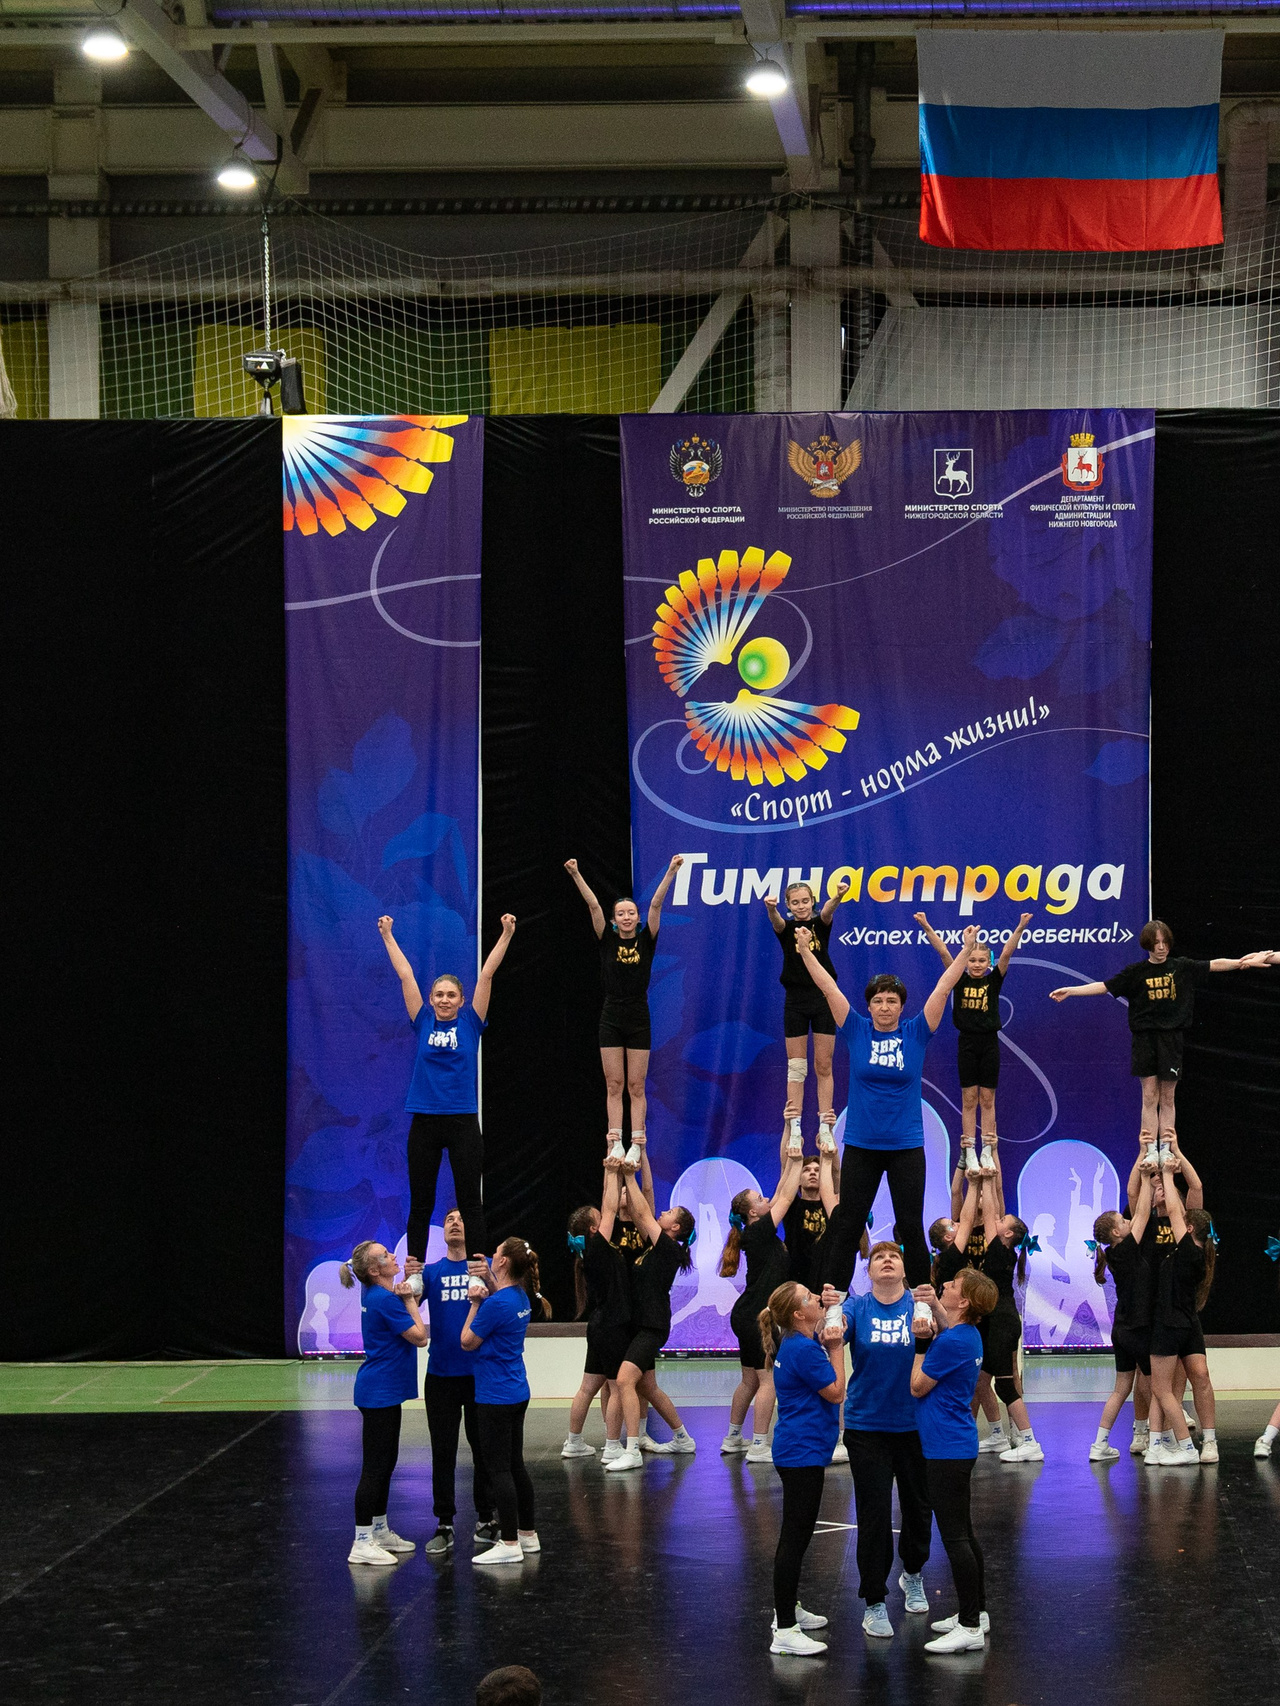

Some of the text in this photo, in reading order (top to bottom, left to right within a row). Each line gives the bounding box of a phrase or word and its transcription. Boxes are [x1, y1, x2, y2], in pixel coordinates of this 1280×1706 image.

[1060, 495, 1105, 503] ДЕПАРТАМЕНТ
[904, 504, 970, 512] МИНИСТЕРСТВО
[1029, 503, 1072, 511] ФИЗИЧЕСКОЙ
[1073, 503, 1105, 511] КУЛЬТУРЫ
[1112, 503, 1136, 511] СПОРТА
[648, 516, 745, 524] РОССИЙСКОЙ ФЕДЕРАЦИИ
[786, 512, 827, 520] РОССИЙСКОЙ
[1055, 512, 1111, 520] АДМИНИСТРАЦИИ
[1080, 520, 1118, 528] НОВГОРОДА
[730, 789, 833, 827] «Спорт
[860, 742, 941, 793] норма
[944, 696, 1050, 755] жизни!»
[672, 853, 1125, 916] Гимнастрада
[838, 926, 914, 946] «Успех
[1017, 921, 1134, 949] ребенка!»
[1145, 976, 1170, 988] ЧИР
[964, 987, 985, 997] ЧИР
[1148, 988, 1170, 1000] БОР
[961, 999, 982, 1009] БОР
[871, 1039, 898, 1053] ЧИР
[869, 1051, 897, 1067] БОР
[441, 1275, 470, 1288] ЧИР
[441, 1288, 468, 1301] БОР
[871, 1317, 902, 1331] ЧИР
[871, 1331, 901, 1343] БОР
